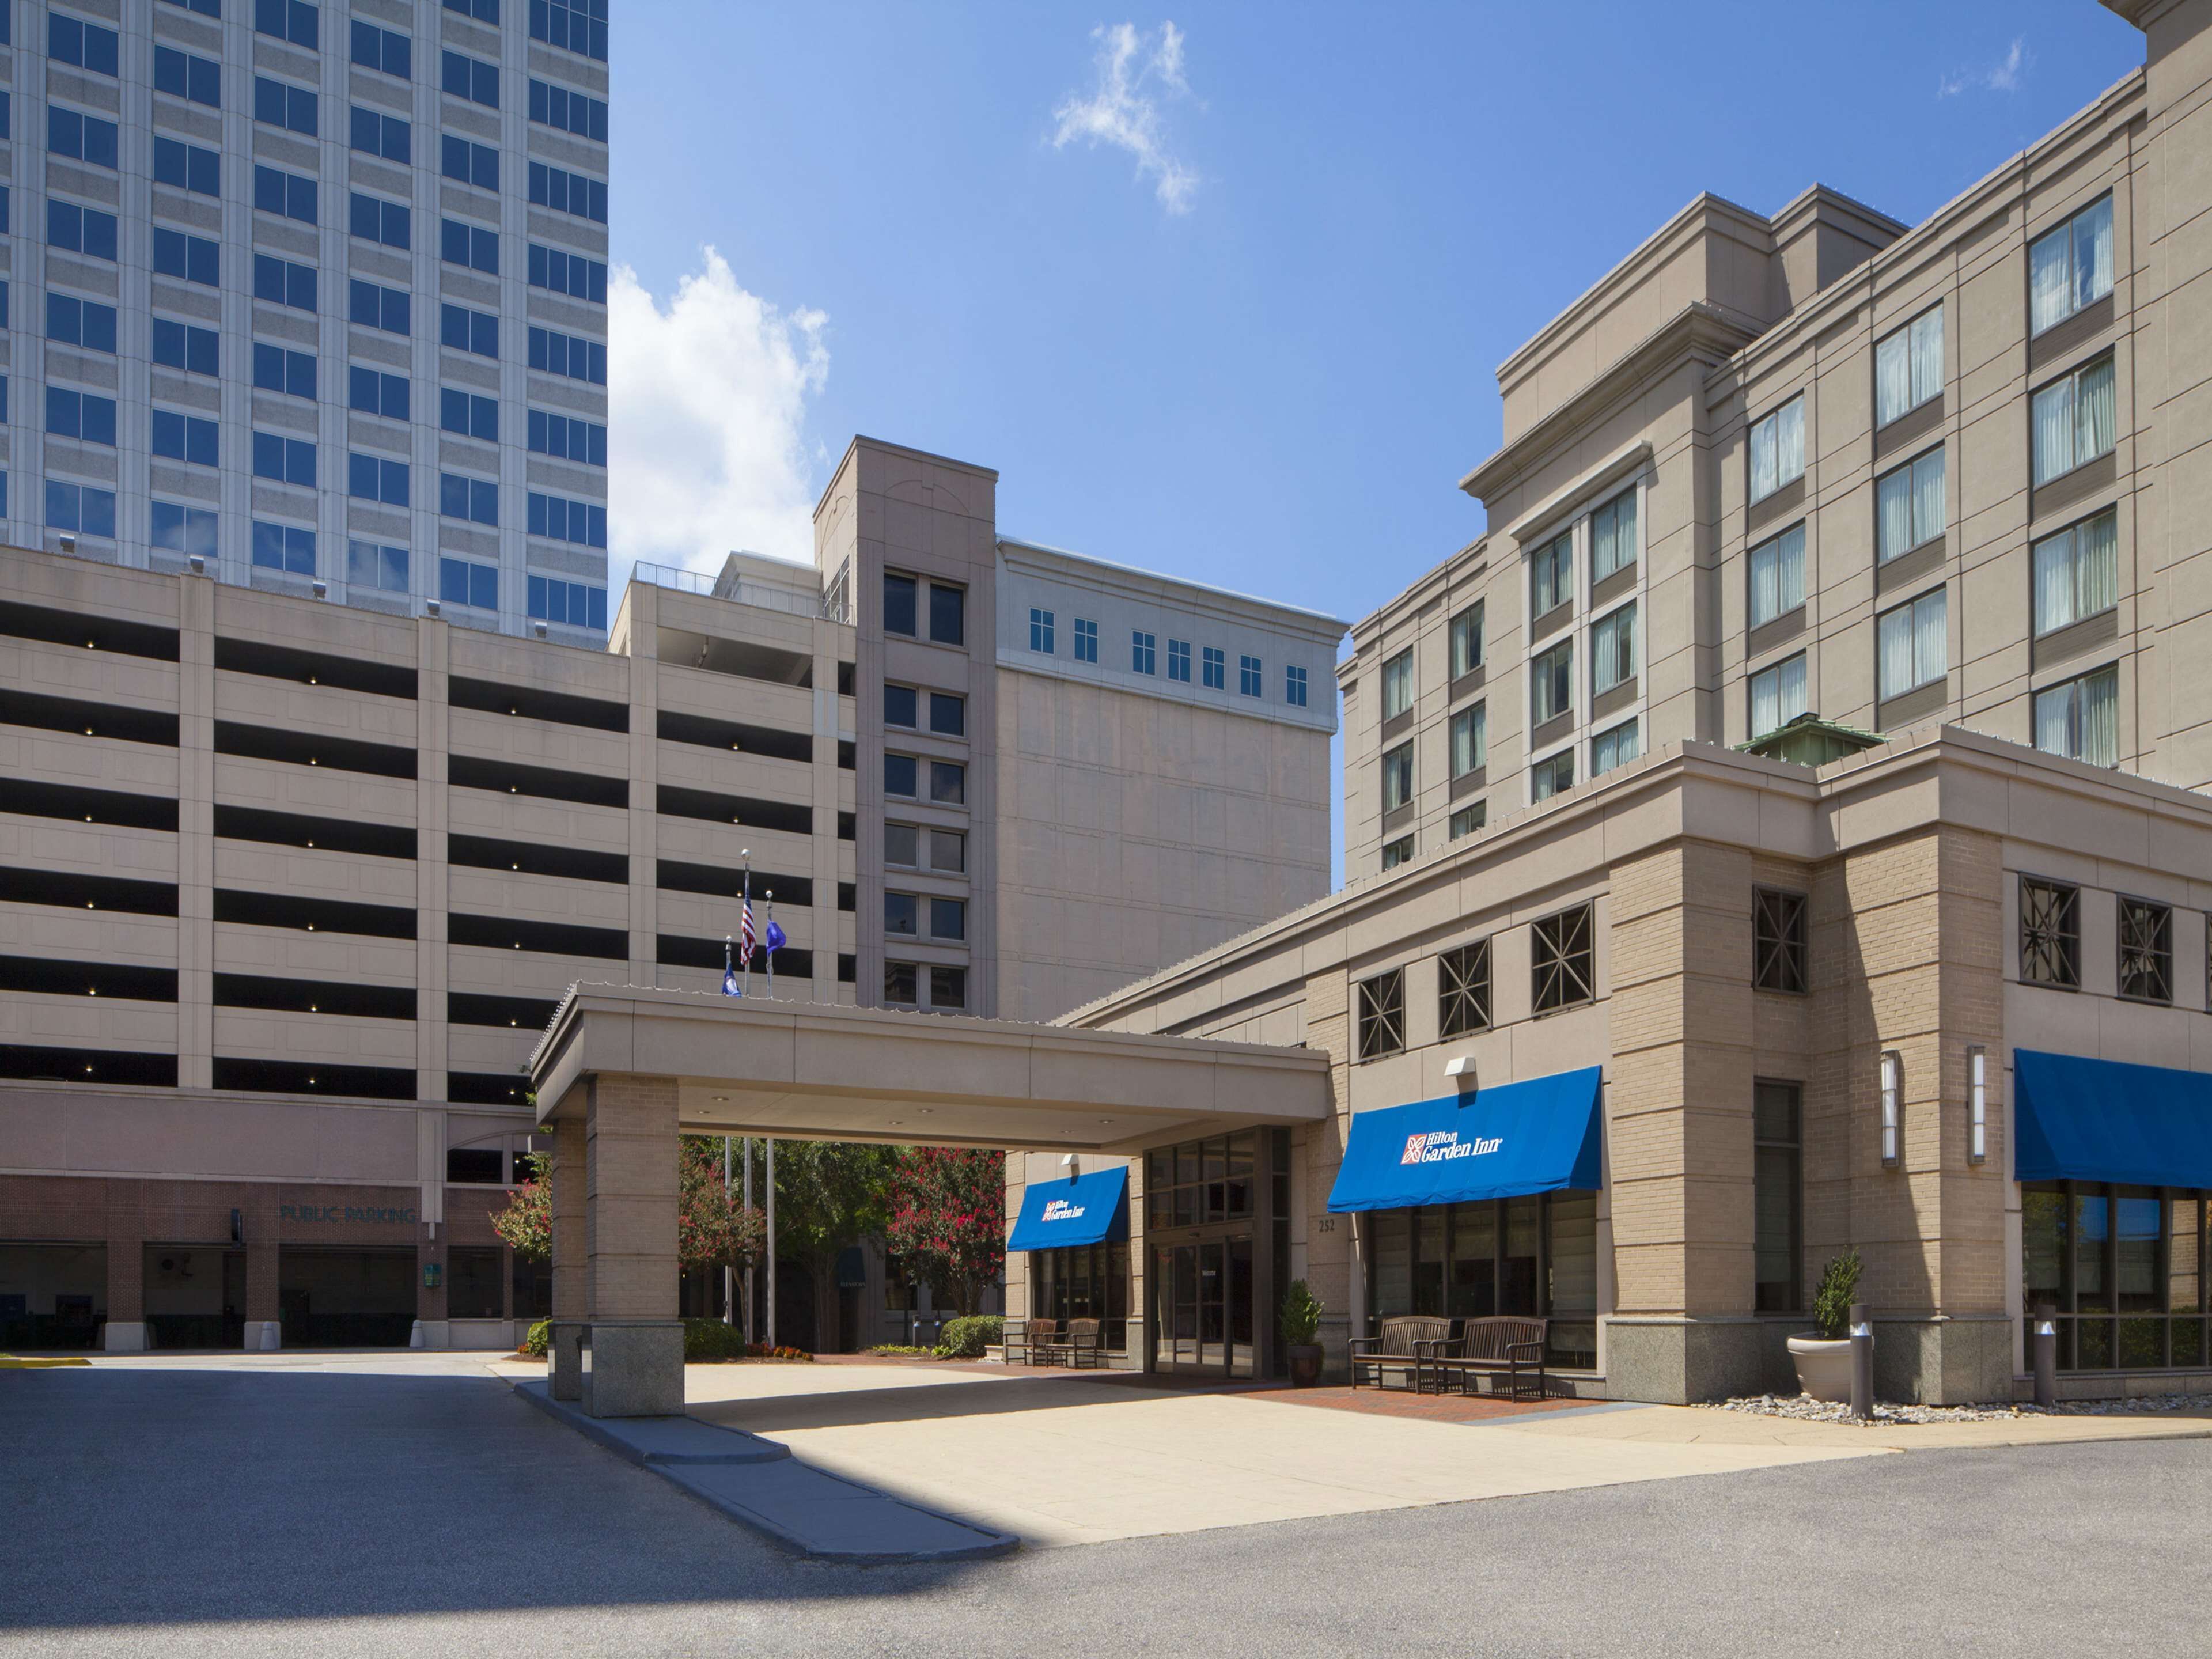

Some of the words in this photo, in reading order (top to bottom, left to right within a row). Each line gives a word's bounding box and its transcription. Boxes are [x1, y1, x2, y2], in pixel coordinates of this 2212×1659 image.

[1426, 1131, 1458, 1146] Hilton
[1421, 1142, 1471, 1162] Garden
[281, 1205, 339, 1222] PUBLIC
[344, 1207, 416, 1224] PARKING
[1051, 1207, 1072, 1221] Garden
[1319, 1219, 1335, 1232] 252
